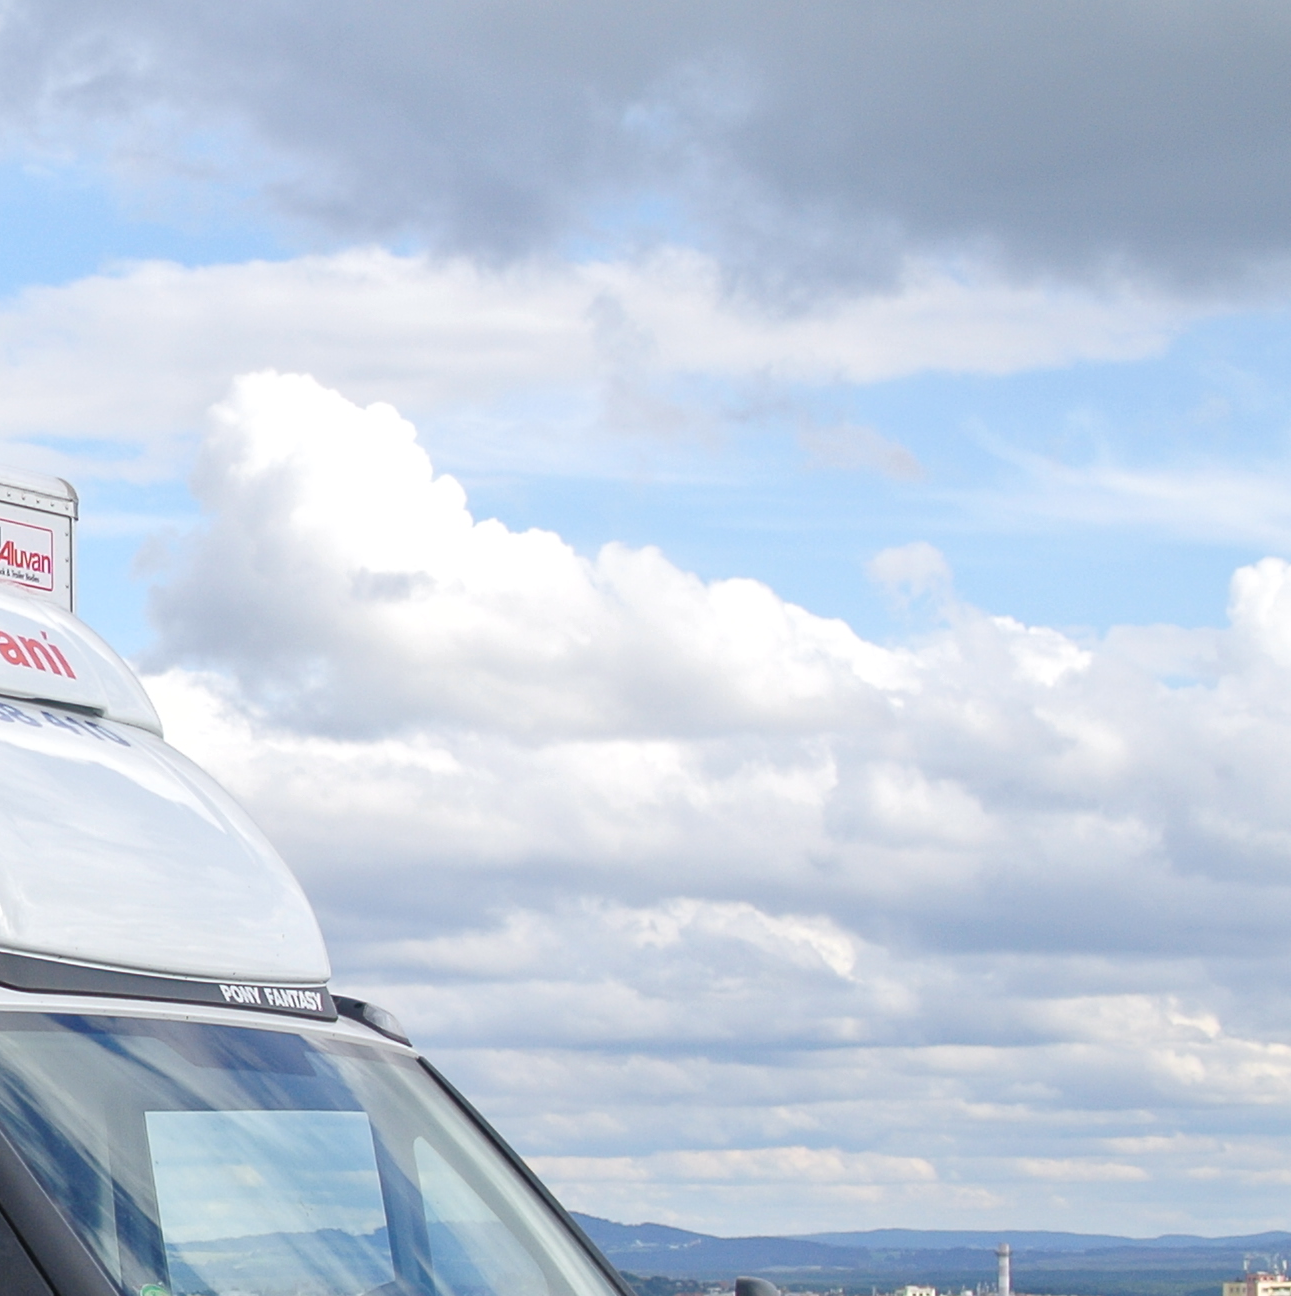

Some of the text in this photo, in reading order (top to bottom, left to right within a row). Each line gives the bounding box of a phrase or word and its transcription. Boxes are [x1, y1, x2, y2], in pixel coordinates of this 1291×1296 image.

[40, 710, 131, 748] 410
[219, 984, 323, 1011] PONY FANTASY
